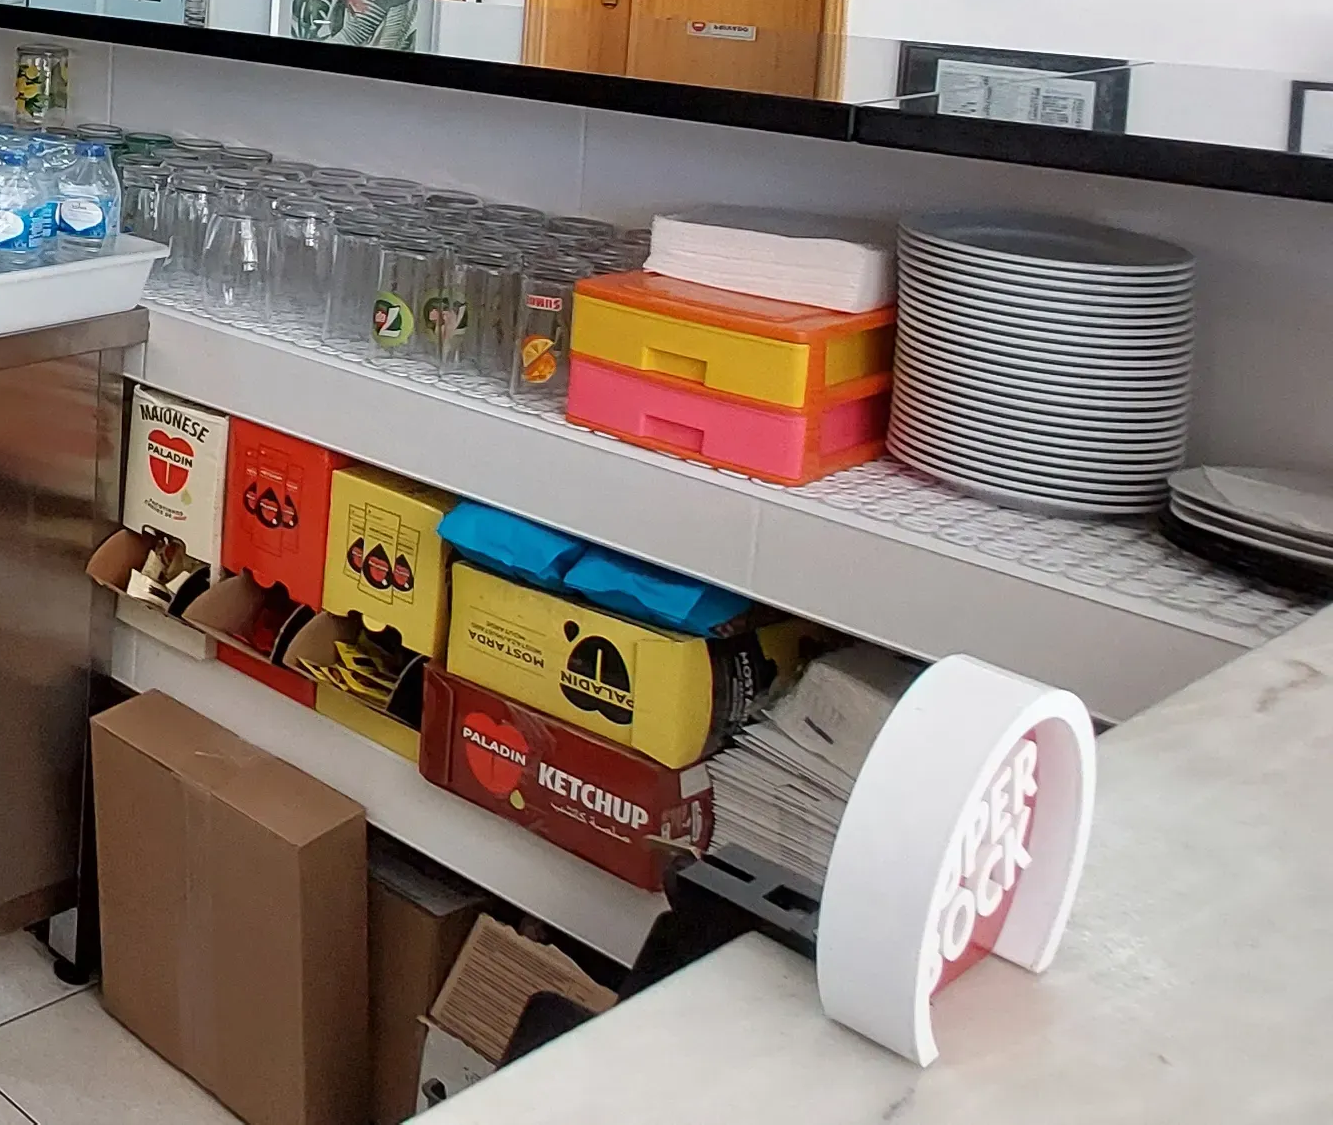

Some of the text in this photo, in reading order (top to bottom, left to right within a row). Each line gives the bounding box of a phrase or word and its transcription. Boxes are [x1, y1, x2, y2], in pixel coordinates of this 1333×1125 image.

[140, 403, 210, 443] MAIONESE
[147, 441, 194, 469] PALADIN
[467, 628, 546, 669] MOSTARDA
[560, 670, 635, 710] PALADIN
[462, 725, 527, 767] PALADIN
[537, 762, 649, 830] KETCHUP
